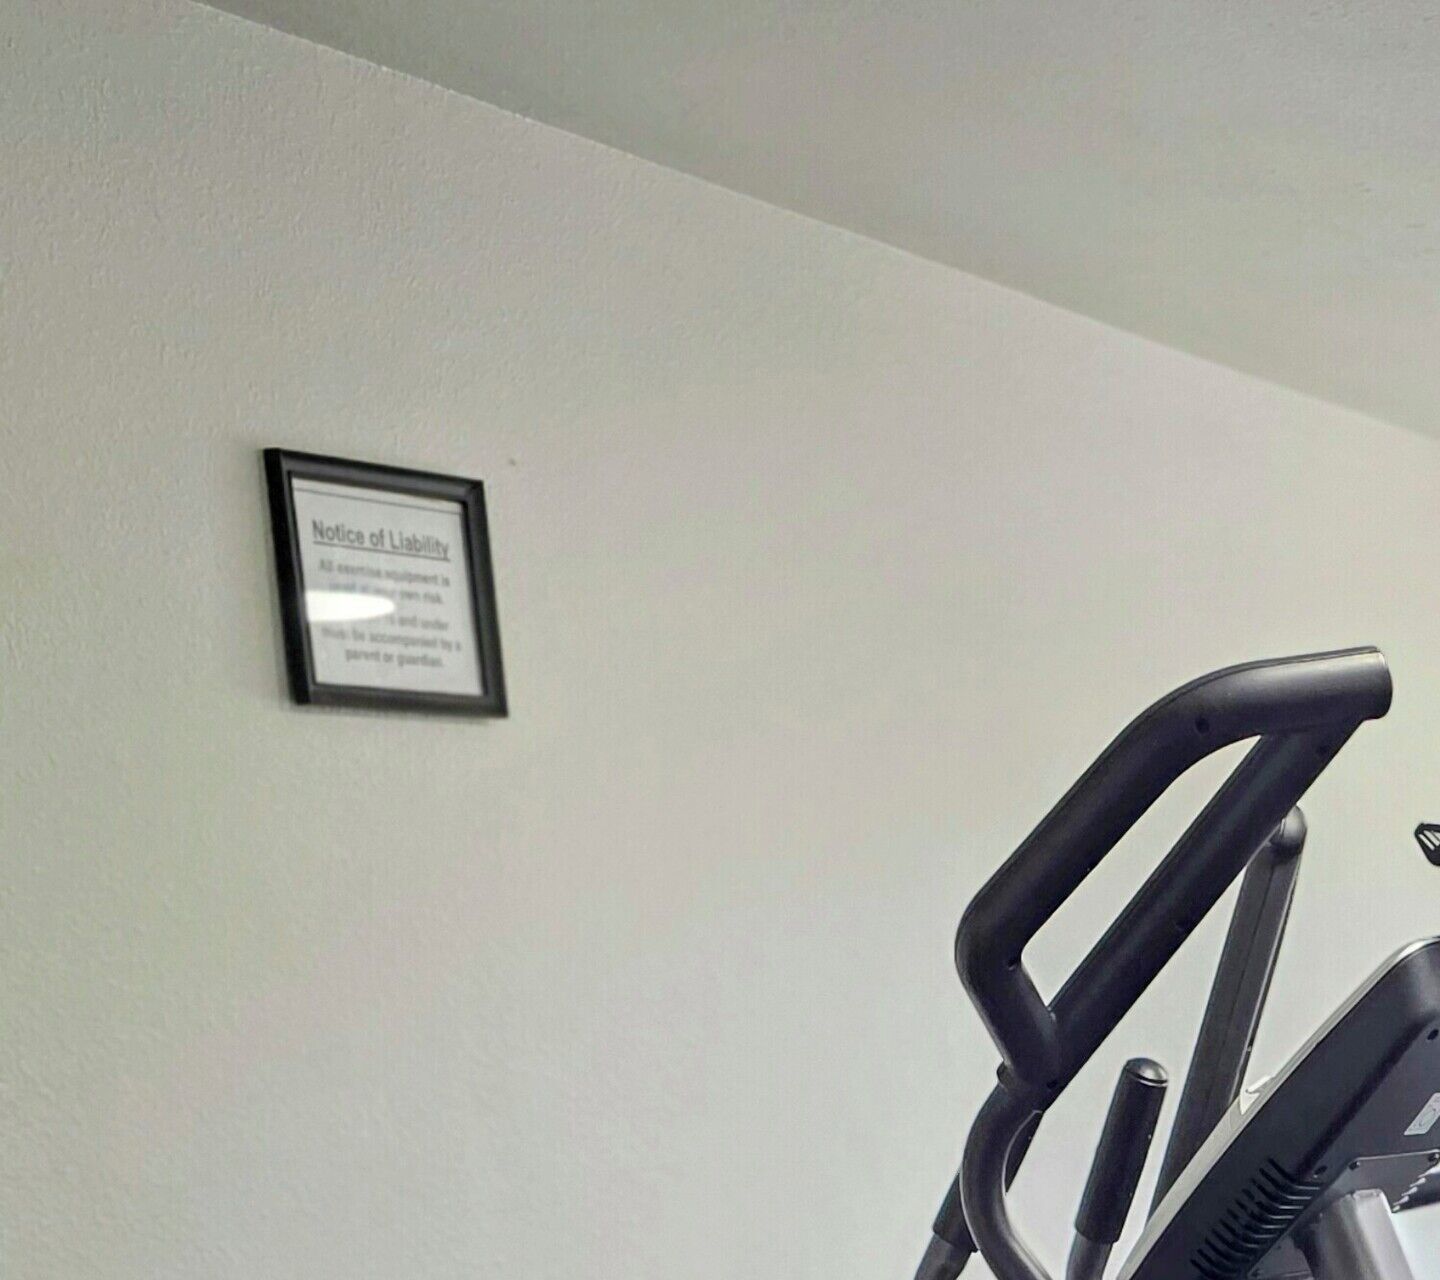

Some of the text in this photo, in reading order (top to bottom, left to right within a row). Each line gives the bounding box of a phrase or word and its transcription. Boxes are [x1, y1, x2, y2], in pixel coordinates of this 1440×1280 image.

[311, 519, 450, 559] Notice of Liability
